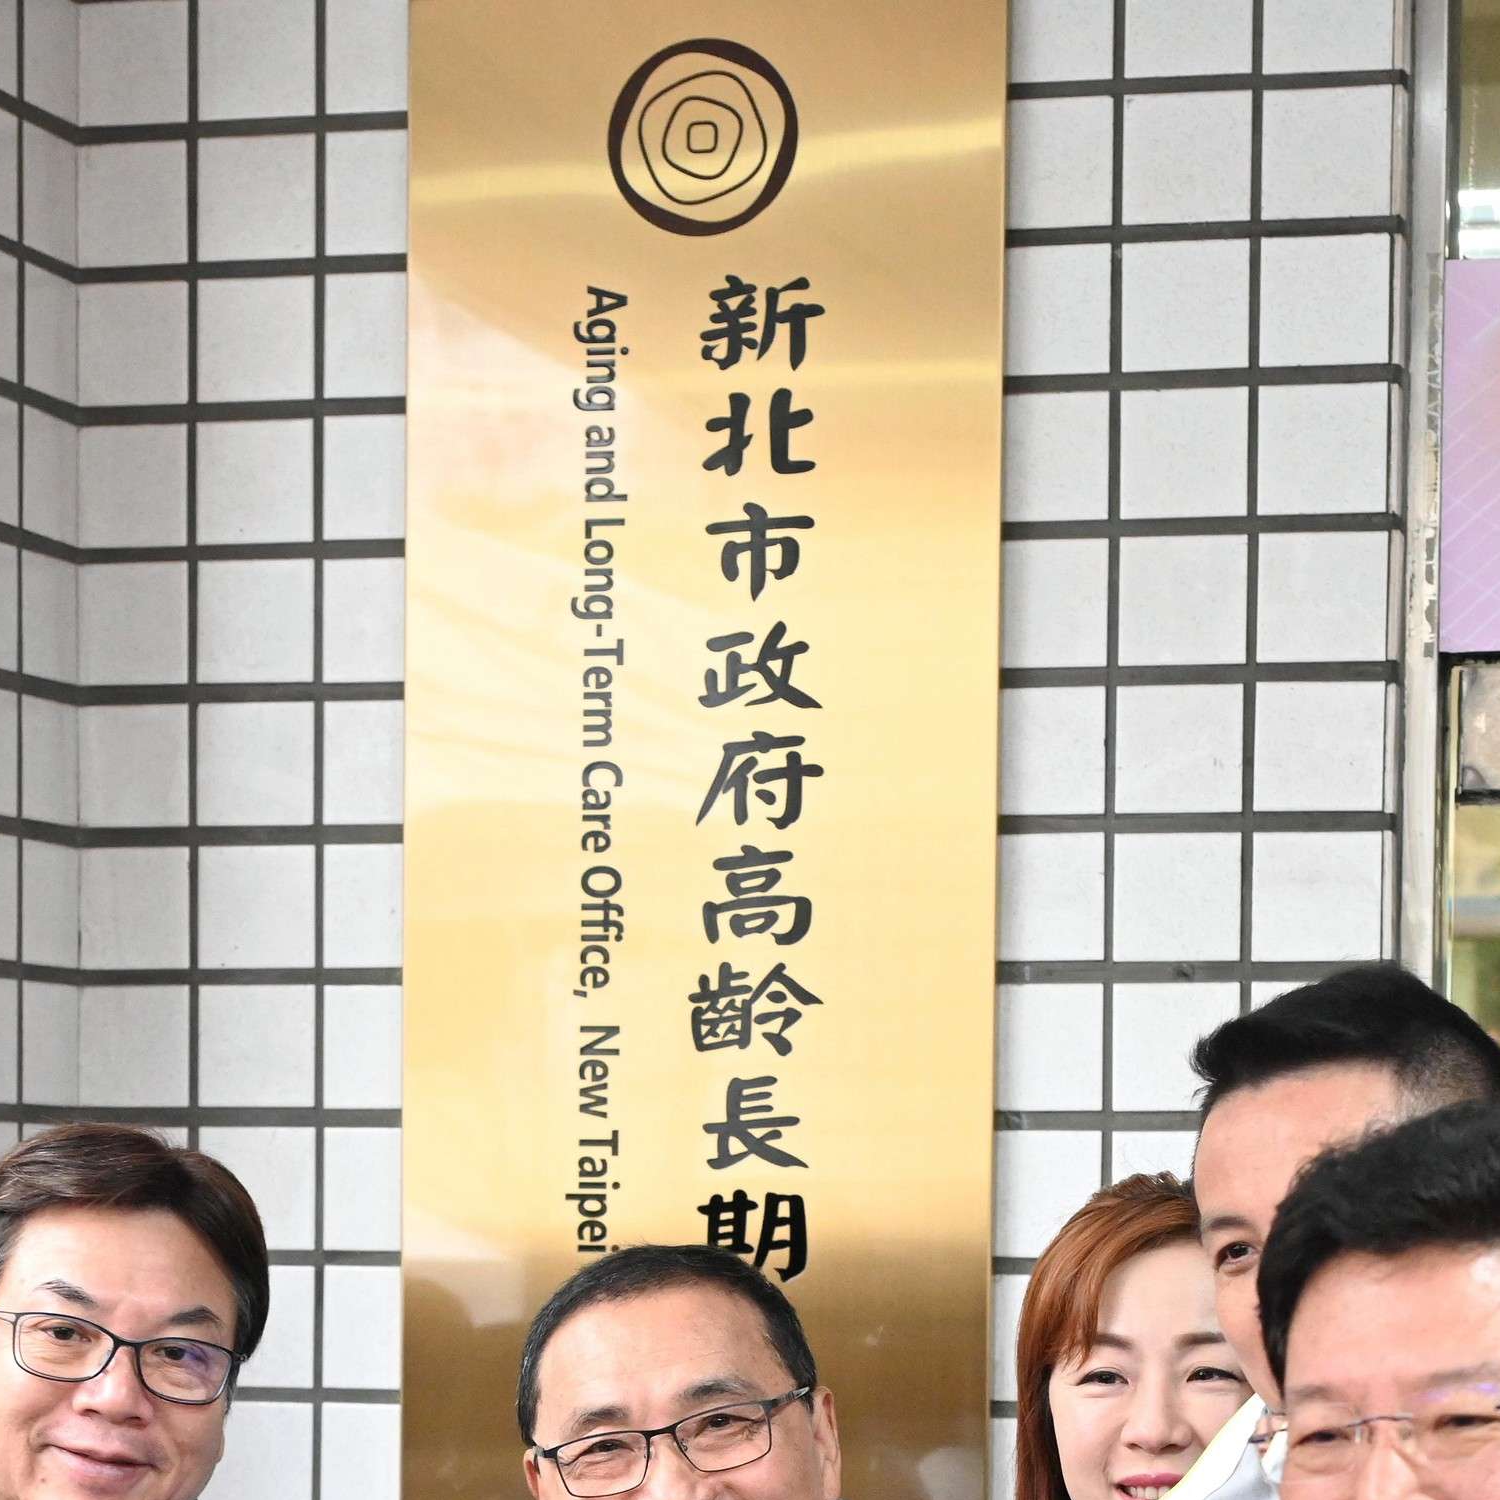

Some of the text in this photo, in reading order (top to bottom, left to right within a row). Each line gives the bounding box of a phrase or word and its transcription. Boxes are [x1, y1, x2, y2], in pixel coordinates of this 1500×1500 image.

[564, 285, 629, 1253] Aging and Long-Term Care Office, New Taipei
[688, 274, 826, 1283] 新北市政府高齡長期
